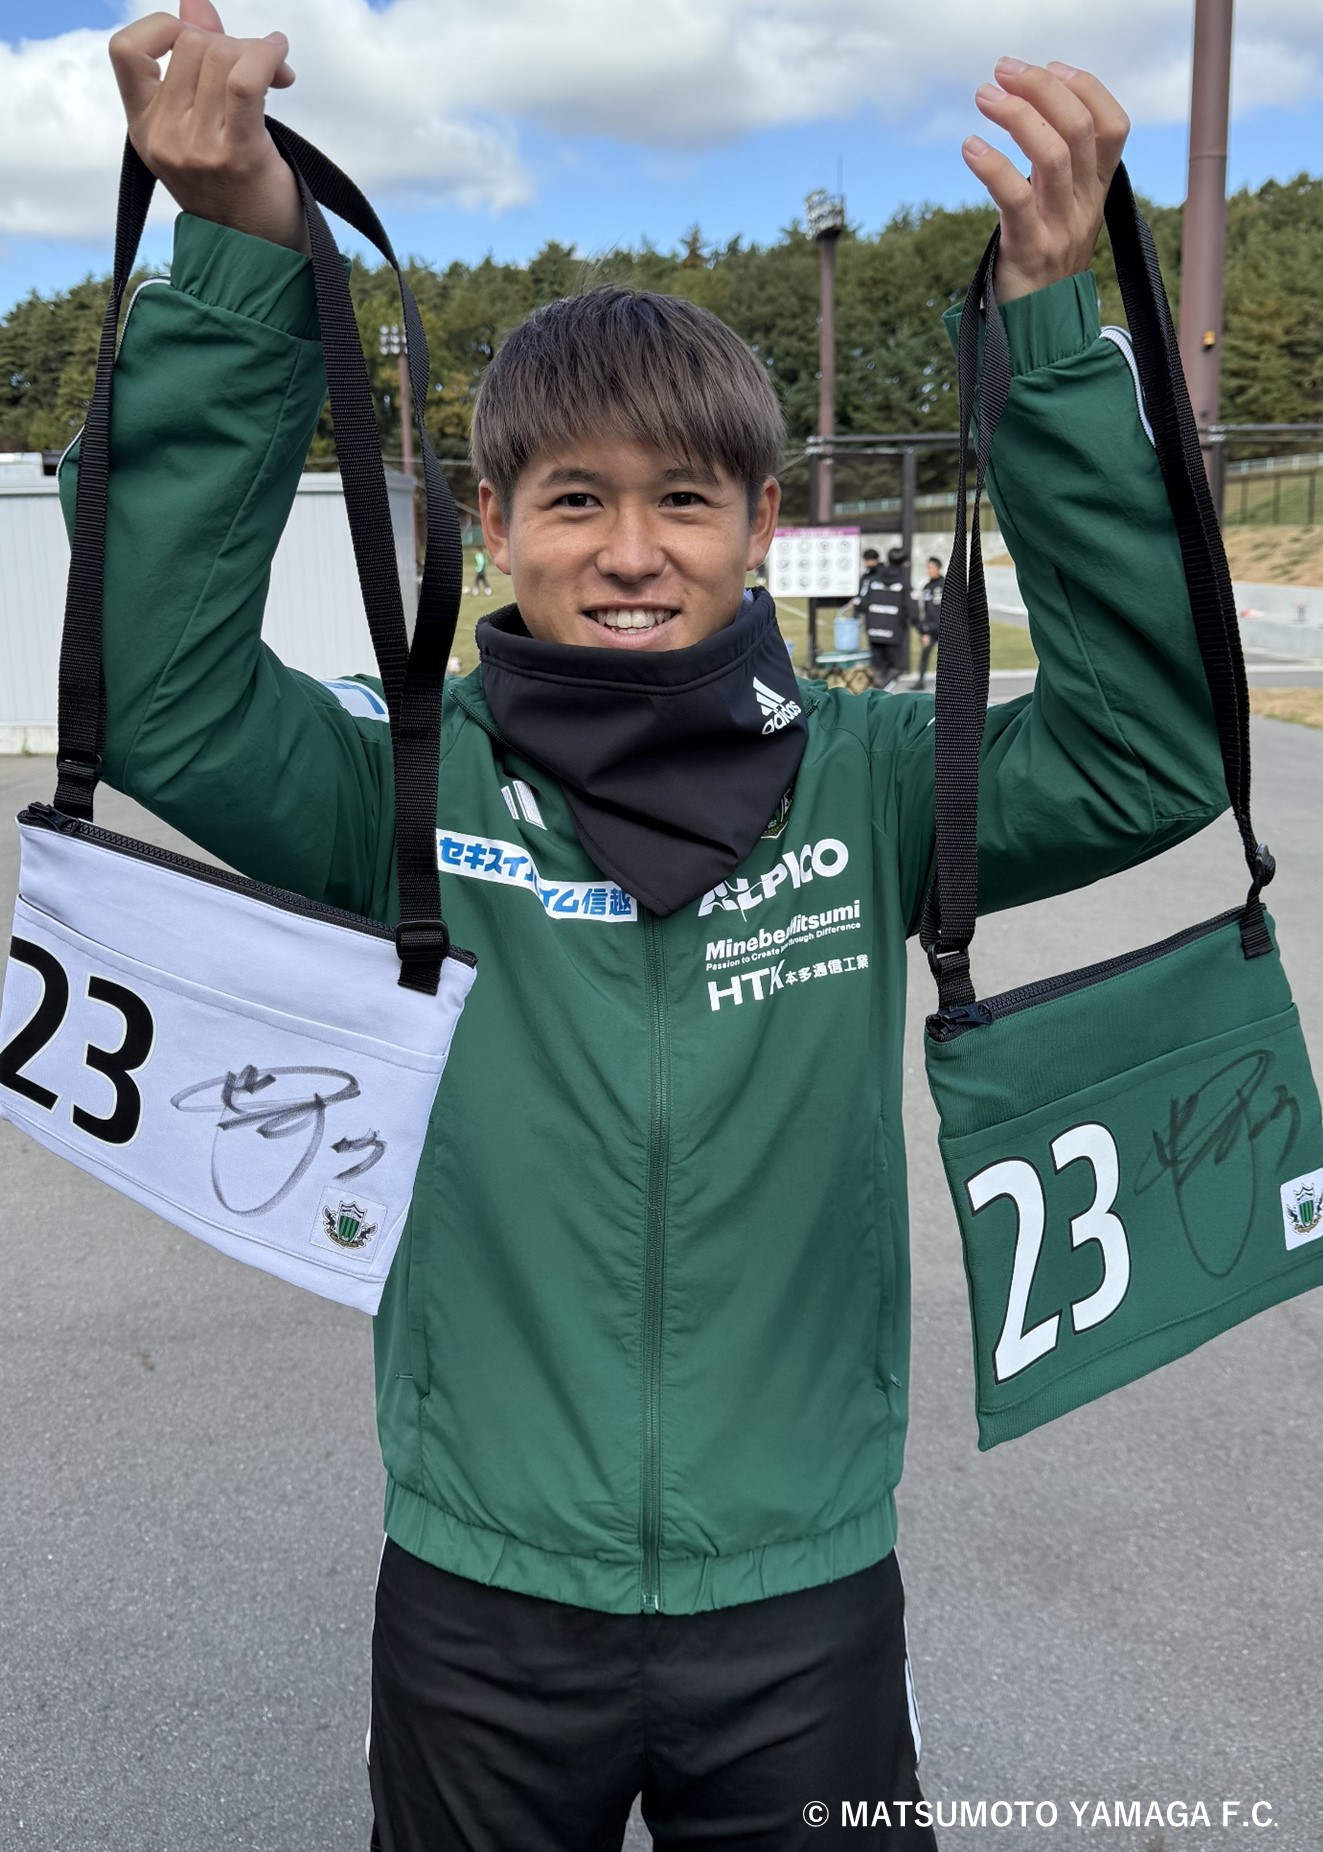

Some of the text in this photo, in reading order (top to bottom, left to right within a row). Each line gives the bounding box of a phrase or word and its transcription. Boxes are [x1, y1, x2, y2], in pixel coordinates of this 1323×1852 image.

[761, 700, 802, 735] adidas
[698, 838, 849, 922] ALPICO
[705, 959, 740, 972] Passion
[741, 956, 751, 964] to
[751, 948, 780, 961] Create
[816, 922, 861, 938] Difference
[707, 954, 869, 1011] HTK 本多通信工業
[0, 935, 156, 1145] 23
[963, 1120, 1131, 1385] 23
